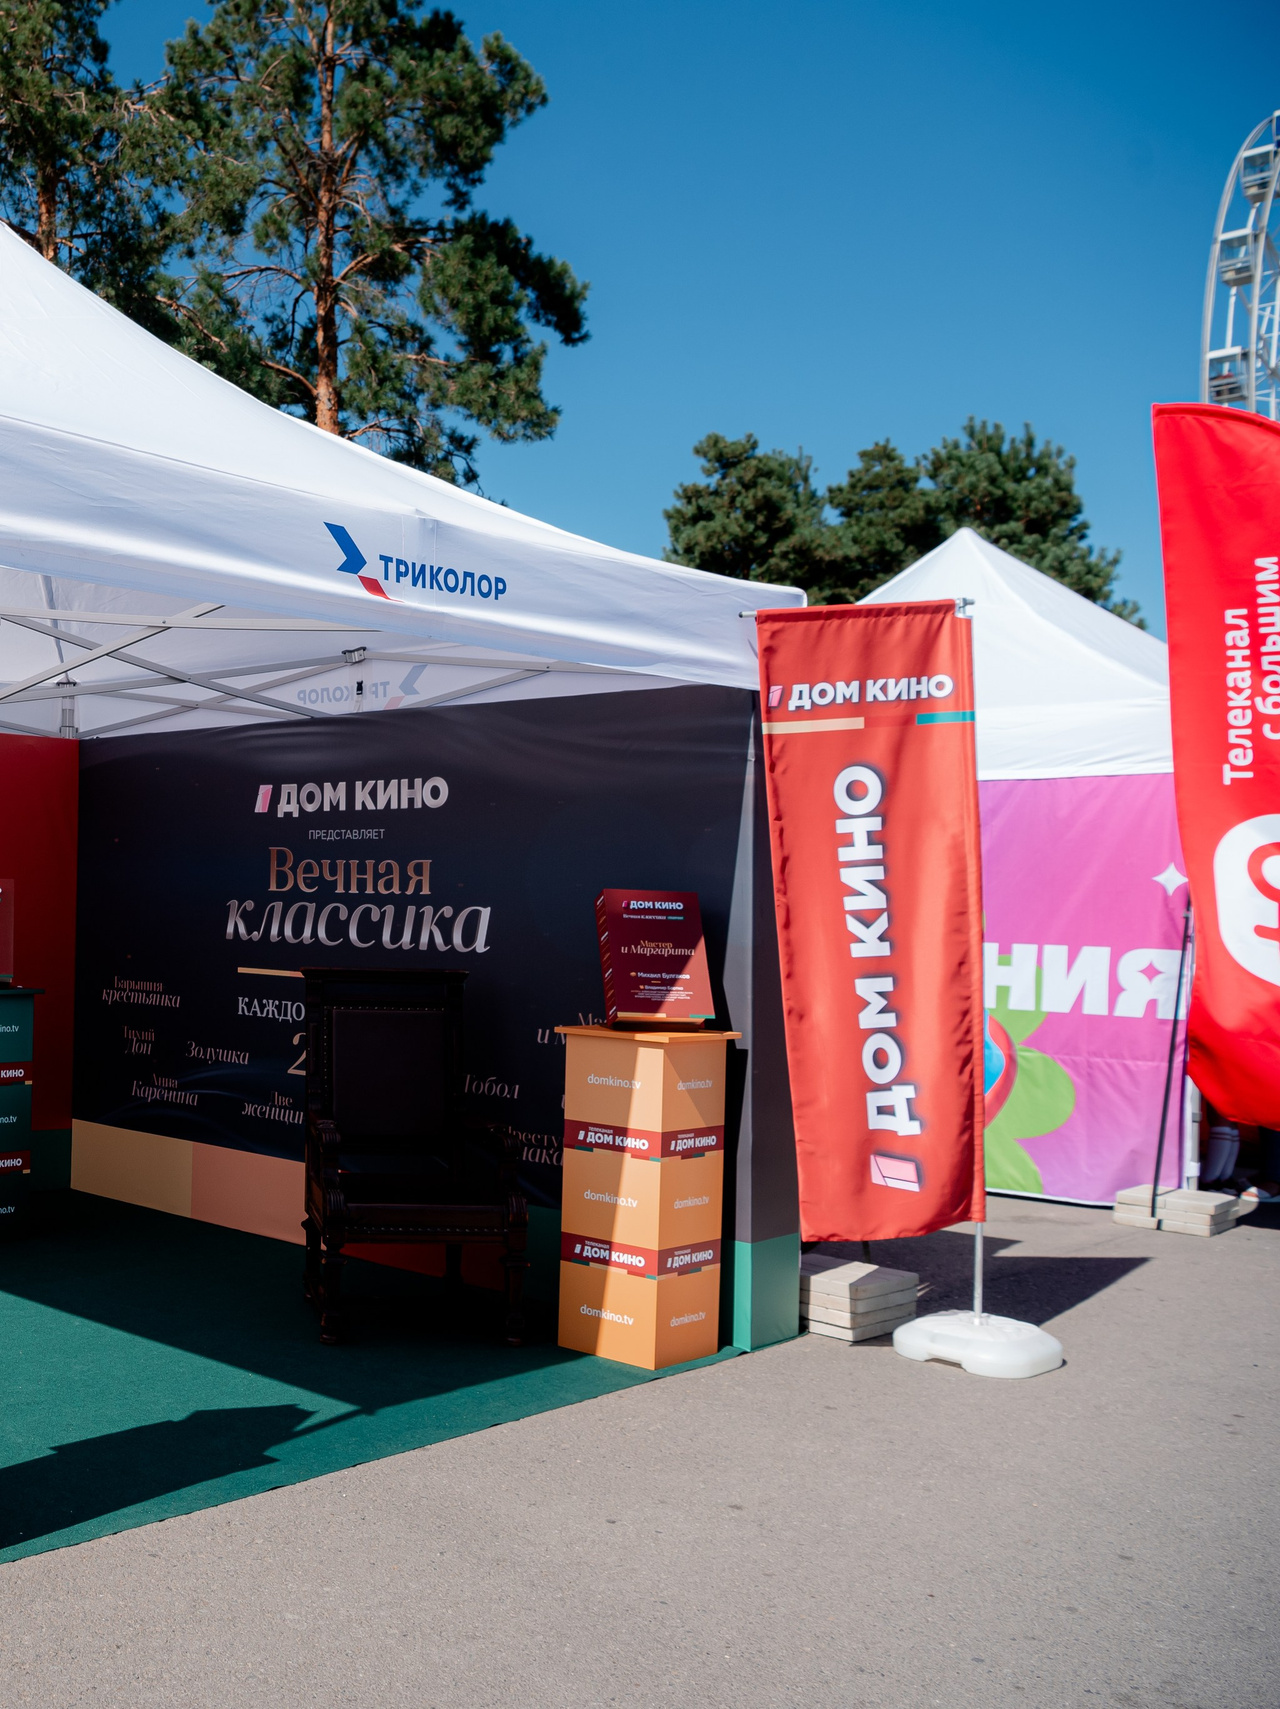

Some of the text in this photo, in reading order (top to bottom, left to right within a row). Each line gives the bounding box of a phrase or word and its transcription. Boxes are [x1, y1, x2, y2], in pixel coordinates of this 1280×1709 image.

[379, 554, 507, 600] ТРИКОЛОР
[1254, 556, 1280, 715] большим
[788, 674, 954, 710] ДОМ КИНО
[1223, 608, 1254, 786] Телеканал
[277, 776, 449, 818] ДОМ КИНО
[308, 829, 386, 841] ПРЕДСТАВЛЯЕТ
[268, 847, 433, 895] Вечная
[630, 900, 684, 910] ДОМ КИНО
[225, 899, 492, 954] классика
[621, 944, 695, 957] и Маргарита
[640, 940, 673, 948] Мастер
[833, 765, 922, 1137] ДОМ КИНО
[102, 989, 181, 1008] крестьянка
[123, 1025, 155, 1041] Тихий
[124, 1037, 152, 1055] Дон
[185, 1040, 250, 1066] Золушка
[1, 1069, 24, 1078] КИНО
[587, 1073, 641, 1089] domkino.tv
[131, 1080, 199, 1106] Каренина
[677, 1078, 712, 1091] domkino.tv
[587, 1131, 649, 1150] ДОМ КИНО
[676, 1135, 716, 1151] ДОМ КИНО
[0, 1158, 22, 1168] КИНО
[584, 1189, 637, 1208] domkino.tv
[674, 1196, 709, 1209] domkino.tv
[583, 1246, 645, 1267] ДОМ КИНО
[673, 1249, 713, 1268] ДОМ КИНО
[580, 1304, 634, 1326] domkino.tv
[670, 1311, 705, 1327] domkino.tv
